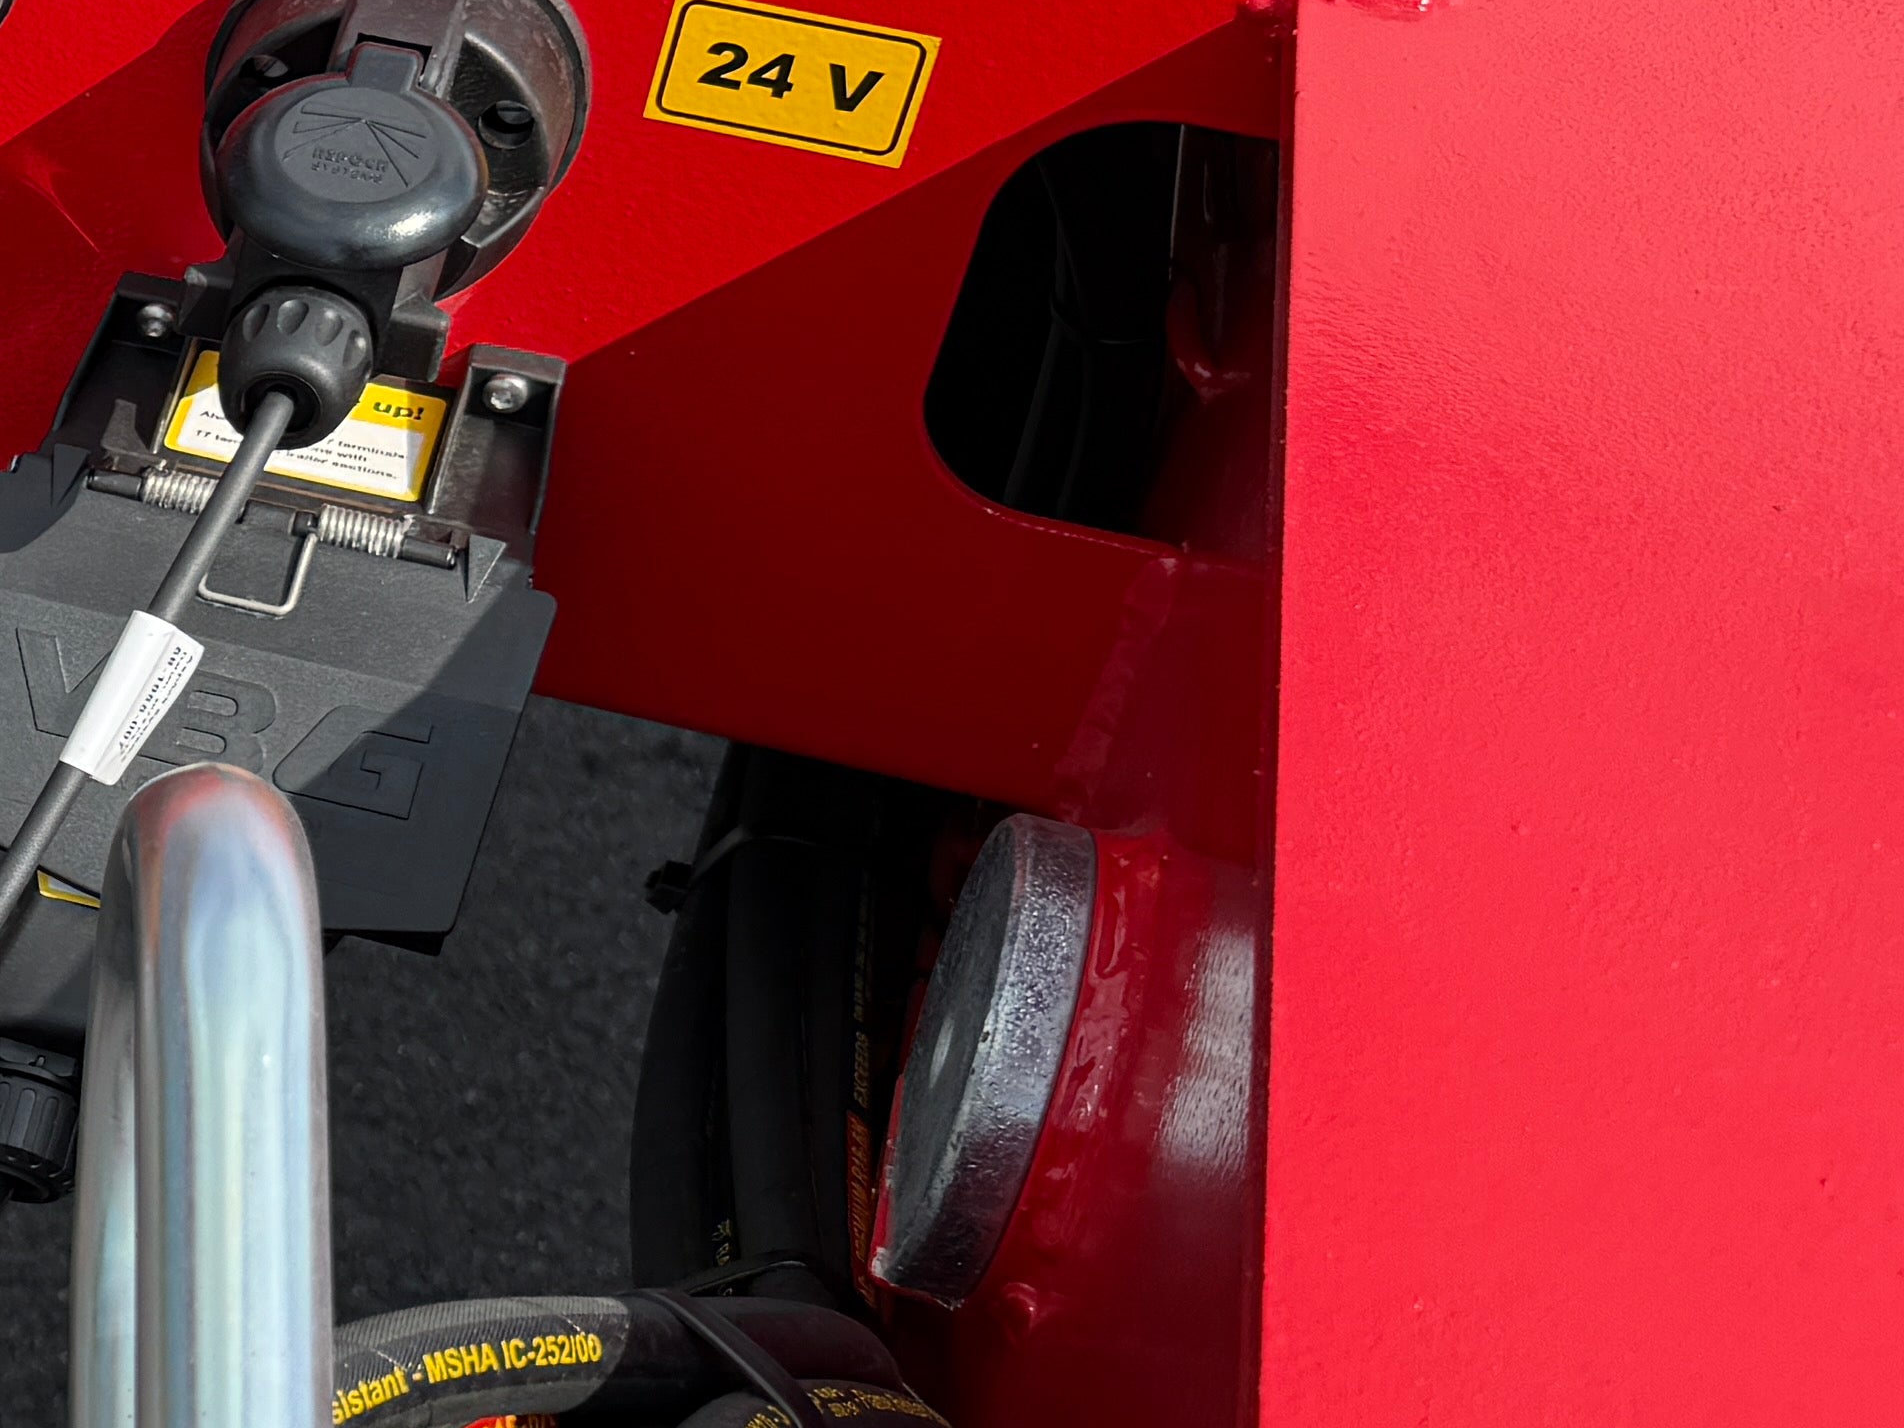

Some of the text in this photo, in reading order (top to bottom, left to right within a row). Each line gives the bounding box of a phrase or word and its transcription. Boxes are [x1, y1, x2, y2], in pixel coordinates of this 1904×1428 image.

[696, 40, 885, 113] 24 V
[372, 400, 425, 421] up!
[332, 1367, 410, 1425] sistant
[422, 1341, 500, 1385] MSHA
[503, 1331, 603, 1371] IC-252/00
